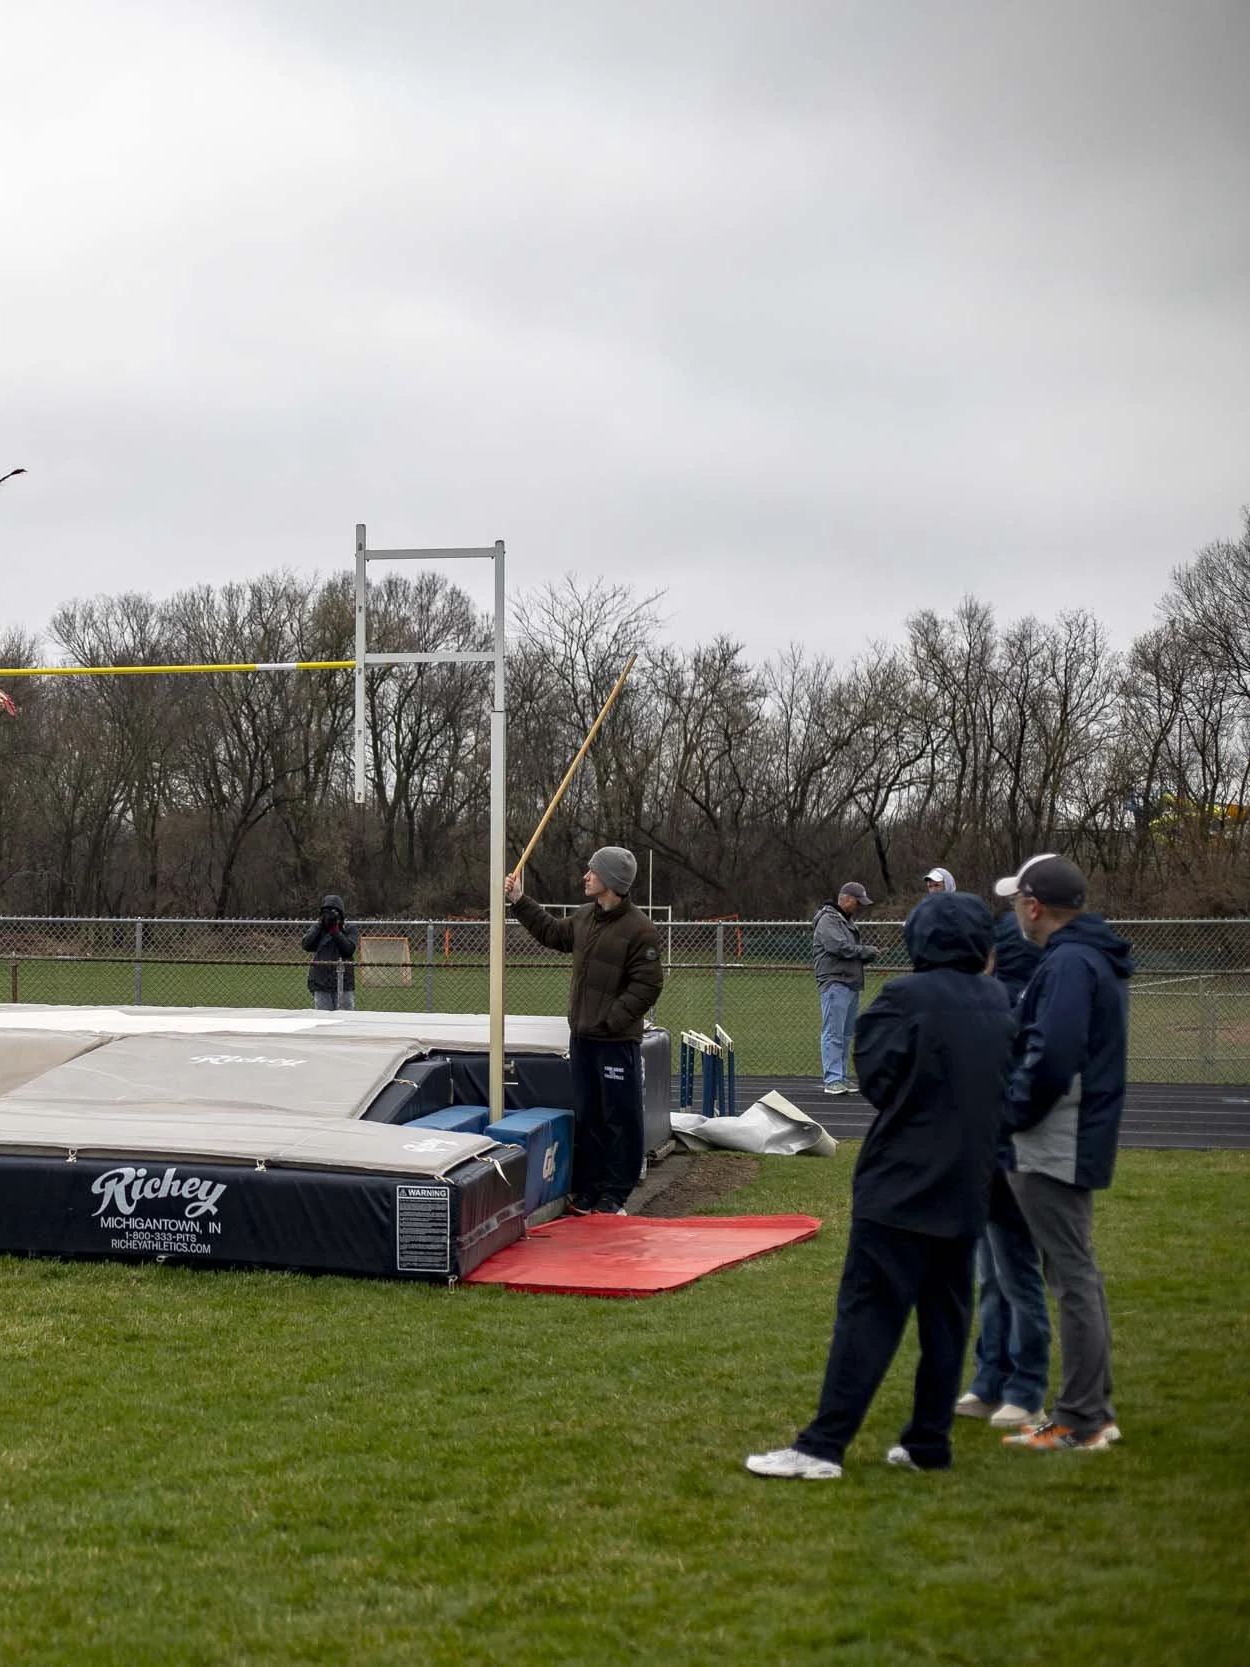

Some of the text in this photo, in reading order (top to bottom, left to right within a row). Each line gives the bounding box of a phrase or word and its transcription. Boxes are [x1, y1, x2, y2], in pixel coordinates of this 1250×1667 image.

[91, 1167, 227, 1218] Richey
[408, 1189, 446, 1197] WARNING
[100, 1216, 221, 1234] MICHIGANTOWN, IN
[125, 1231, 196, 1242] 1-800-333-PITS
[111, 1239, 211, 1254] RICHEYATHLETICS.COM
